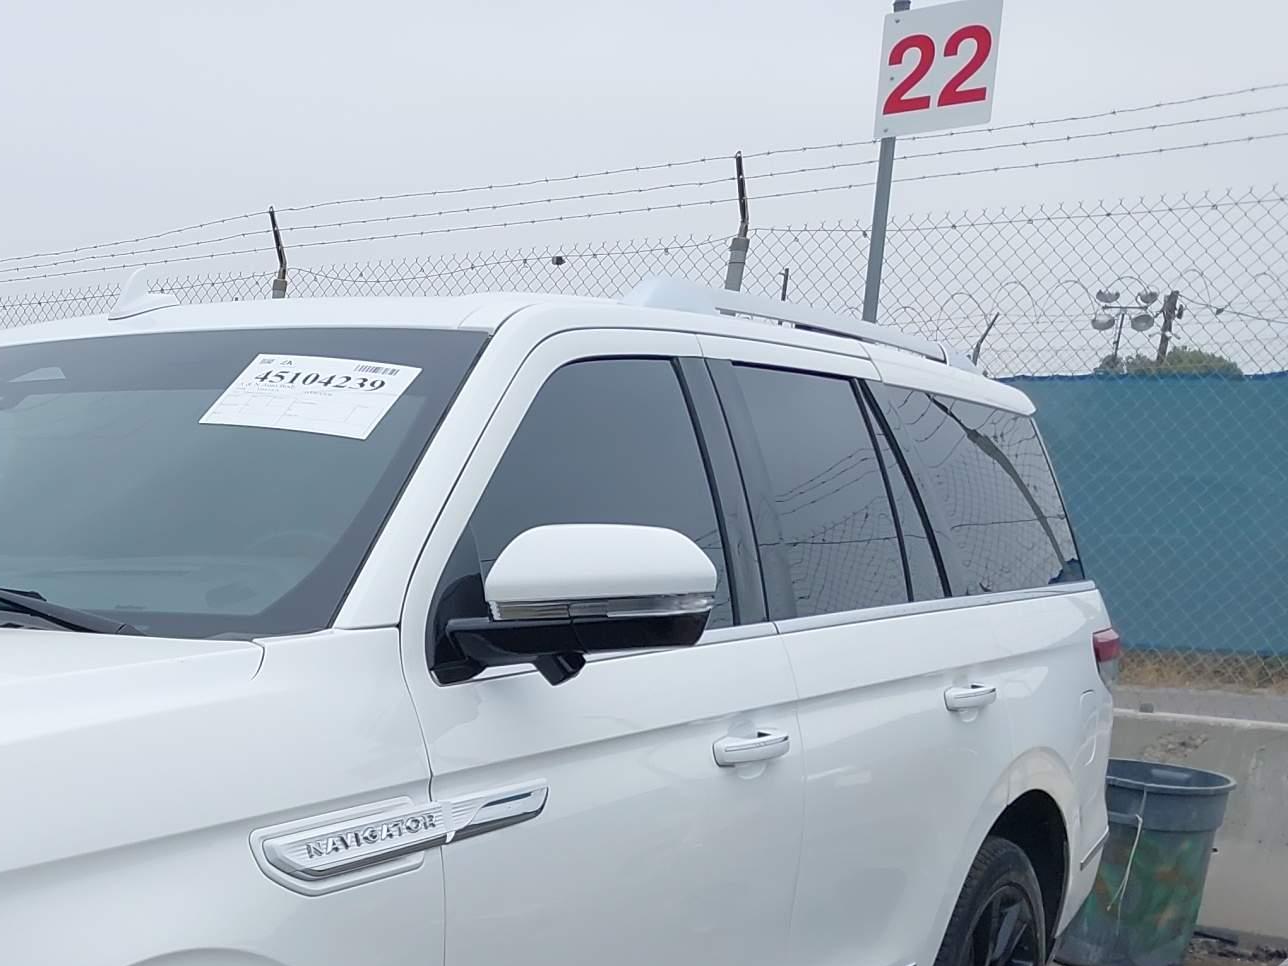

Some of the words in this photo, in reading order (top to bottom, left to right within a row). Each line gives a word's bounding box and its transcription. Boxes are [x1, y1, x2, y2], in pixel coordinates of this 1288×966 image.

[883, 25, 992, 115] 22
[254, 370, 386, 392] 45104239
[306, 814, 436, 858] NAVIGATOR
